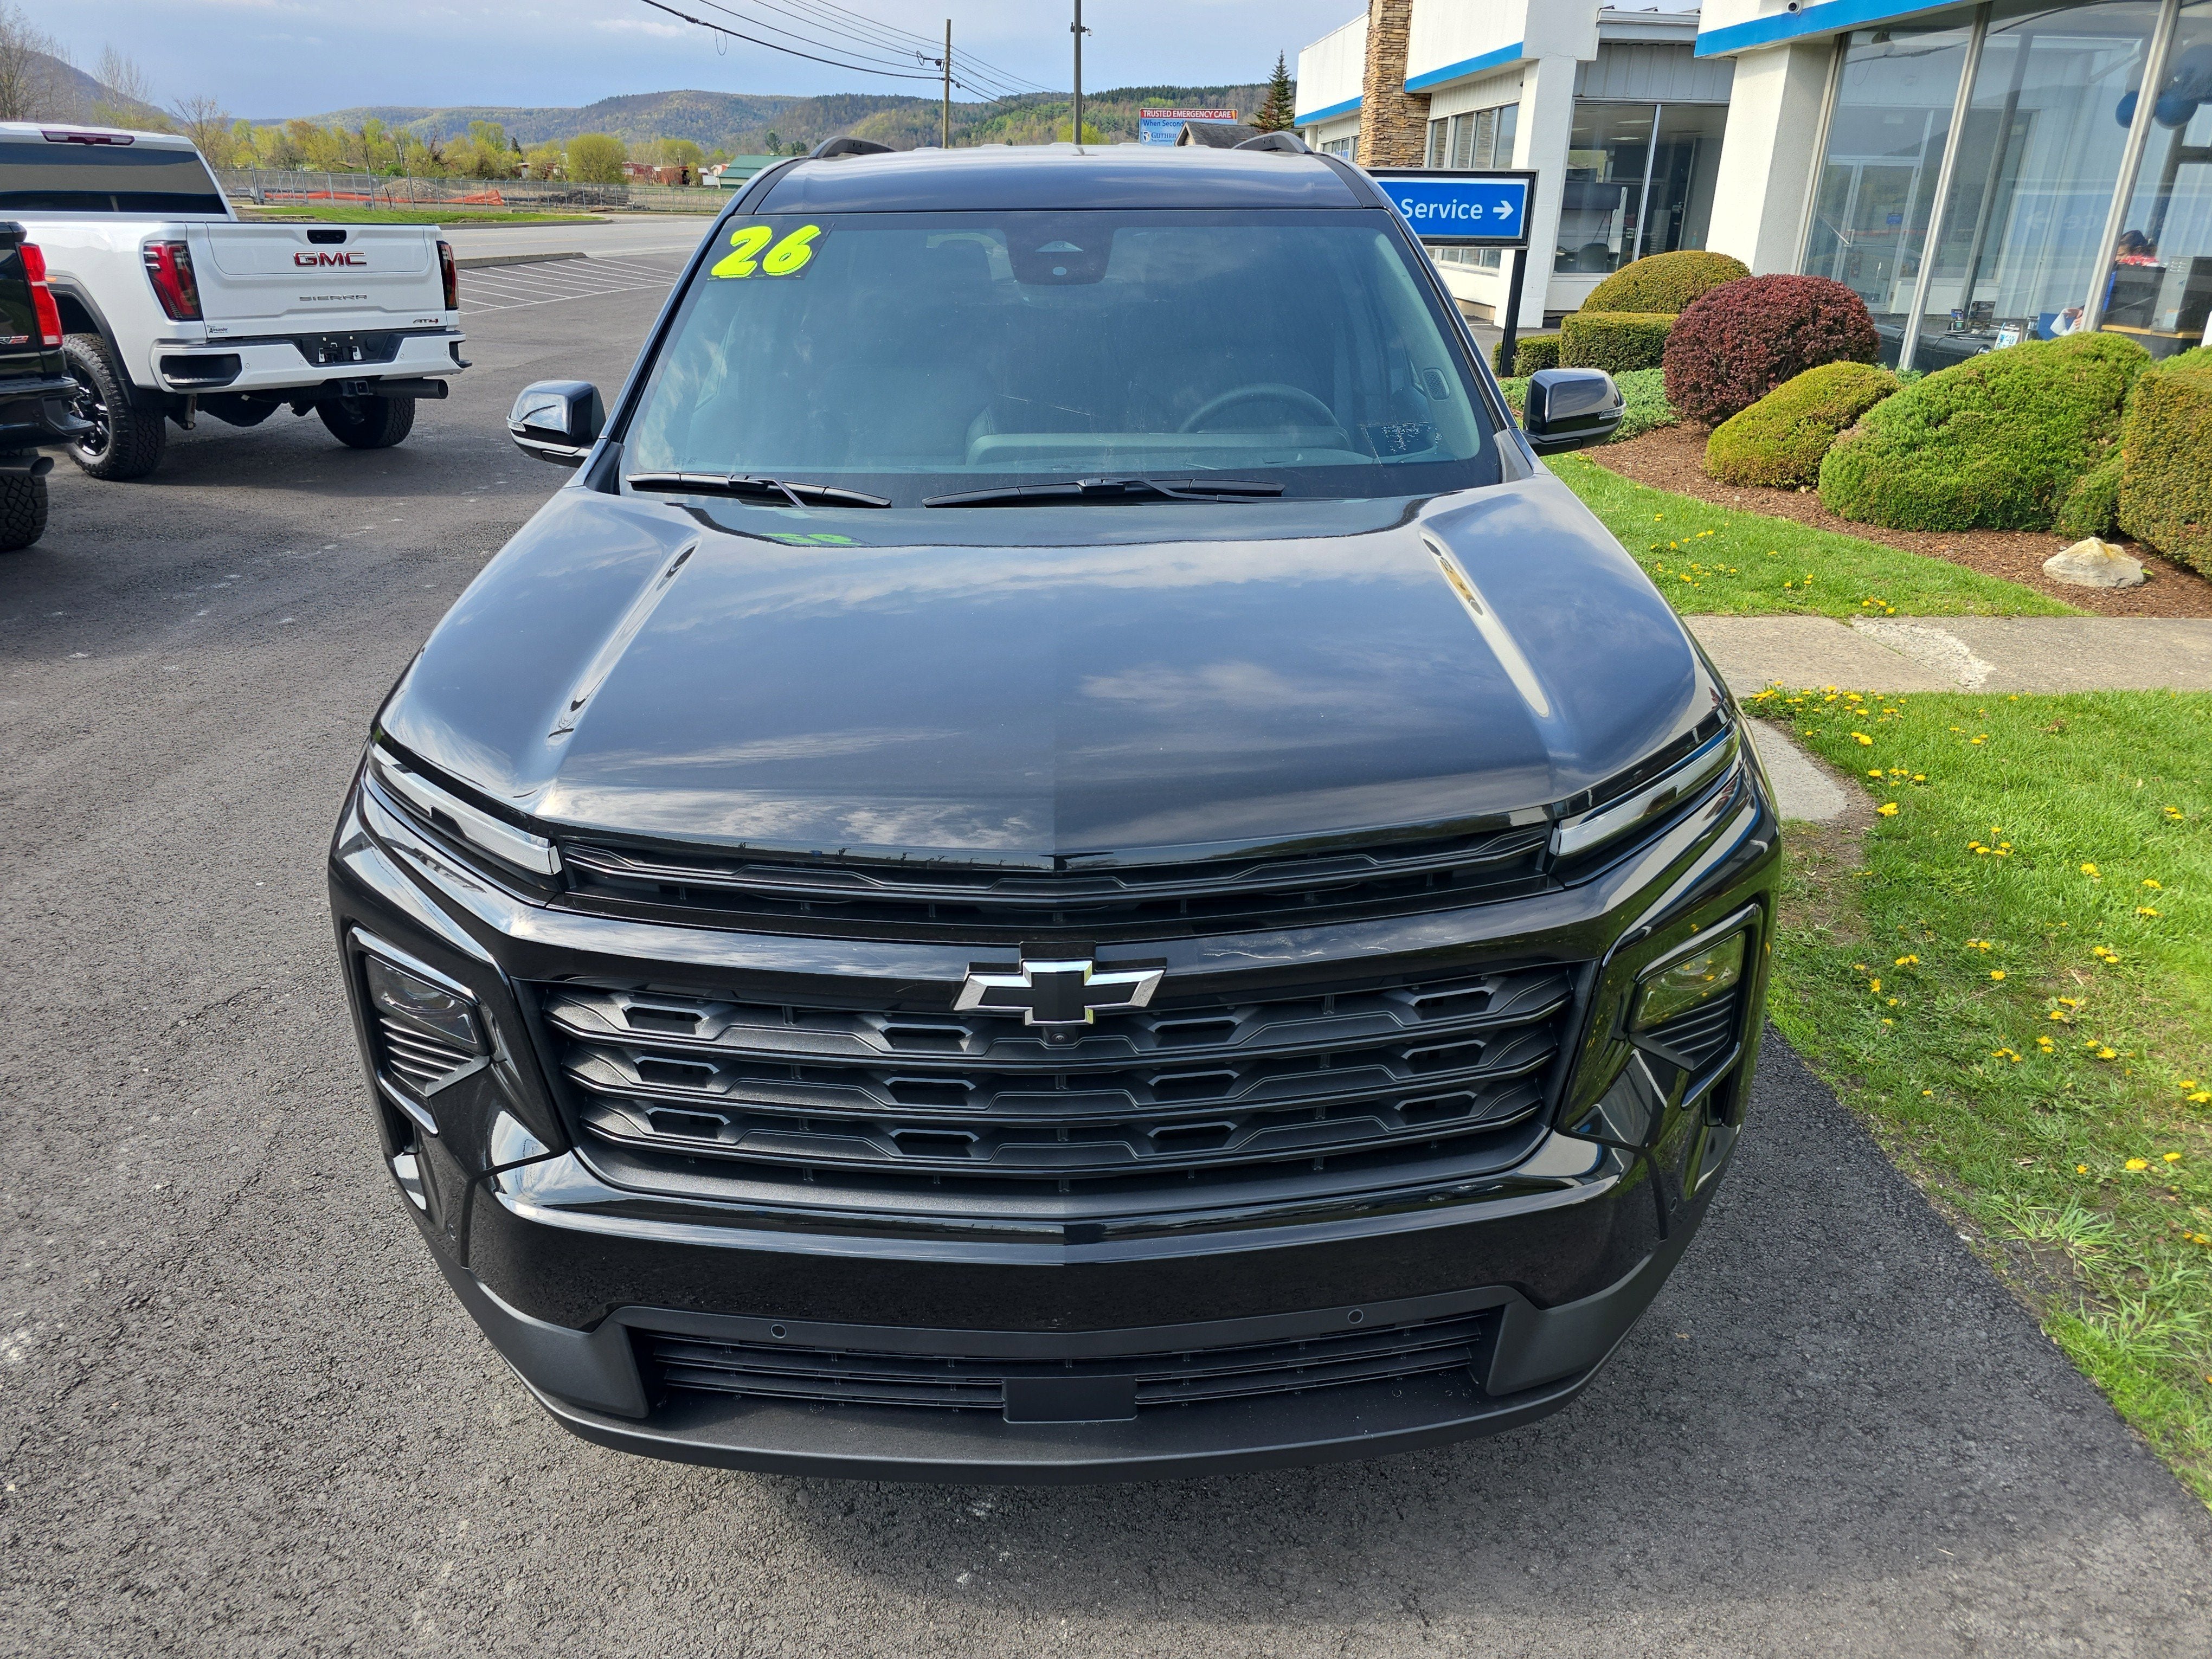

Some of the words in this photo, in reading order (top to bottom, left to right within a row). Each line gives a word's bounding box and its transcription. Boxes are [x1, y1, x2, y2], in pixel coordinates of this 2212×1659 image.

[1173, 110, 1213, 118] EMERGENCY
[1400, 198, 1483, 220] Service
[293, 251, 367, 267] GMC
[711, 224, 821, 279] 26
